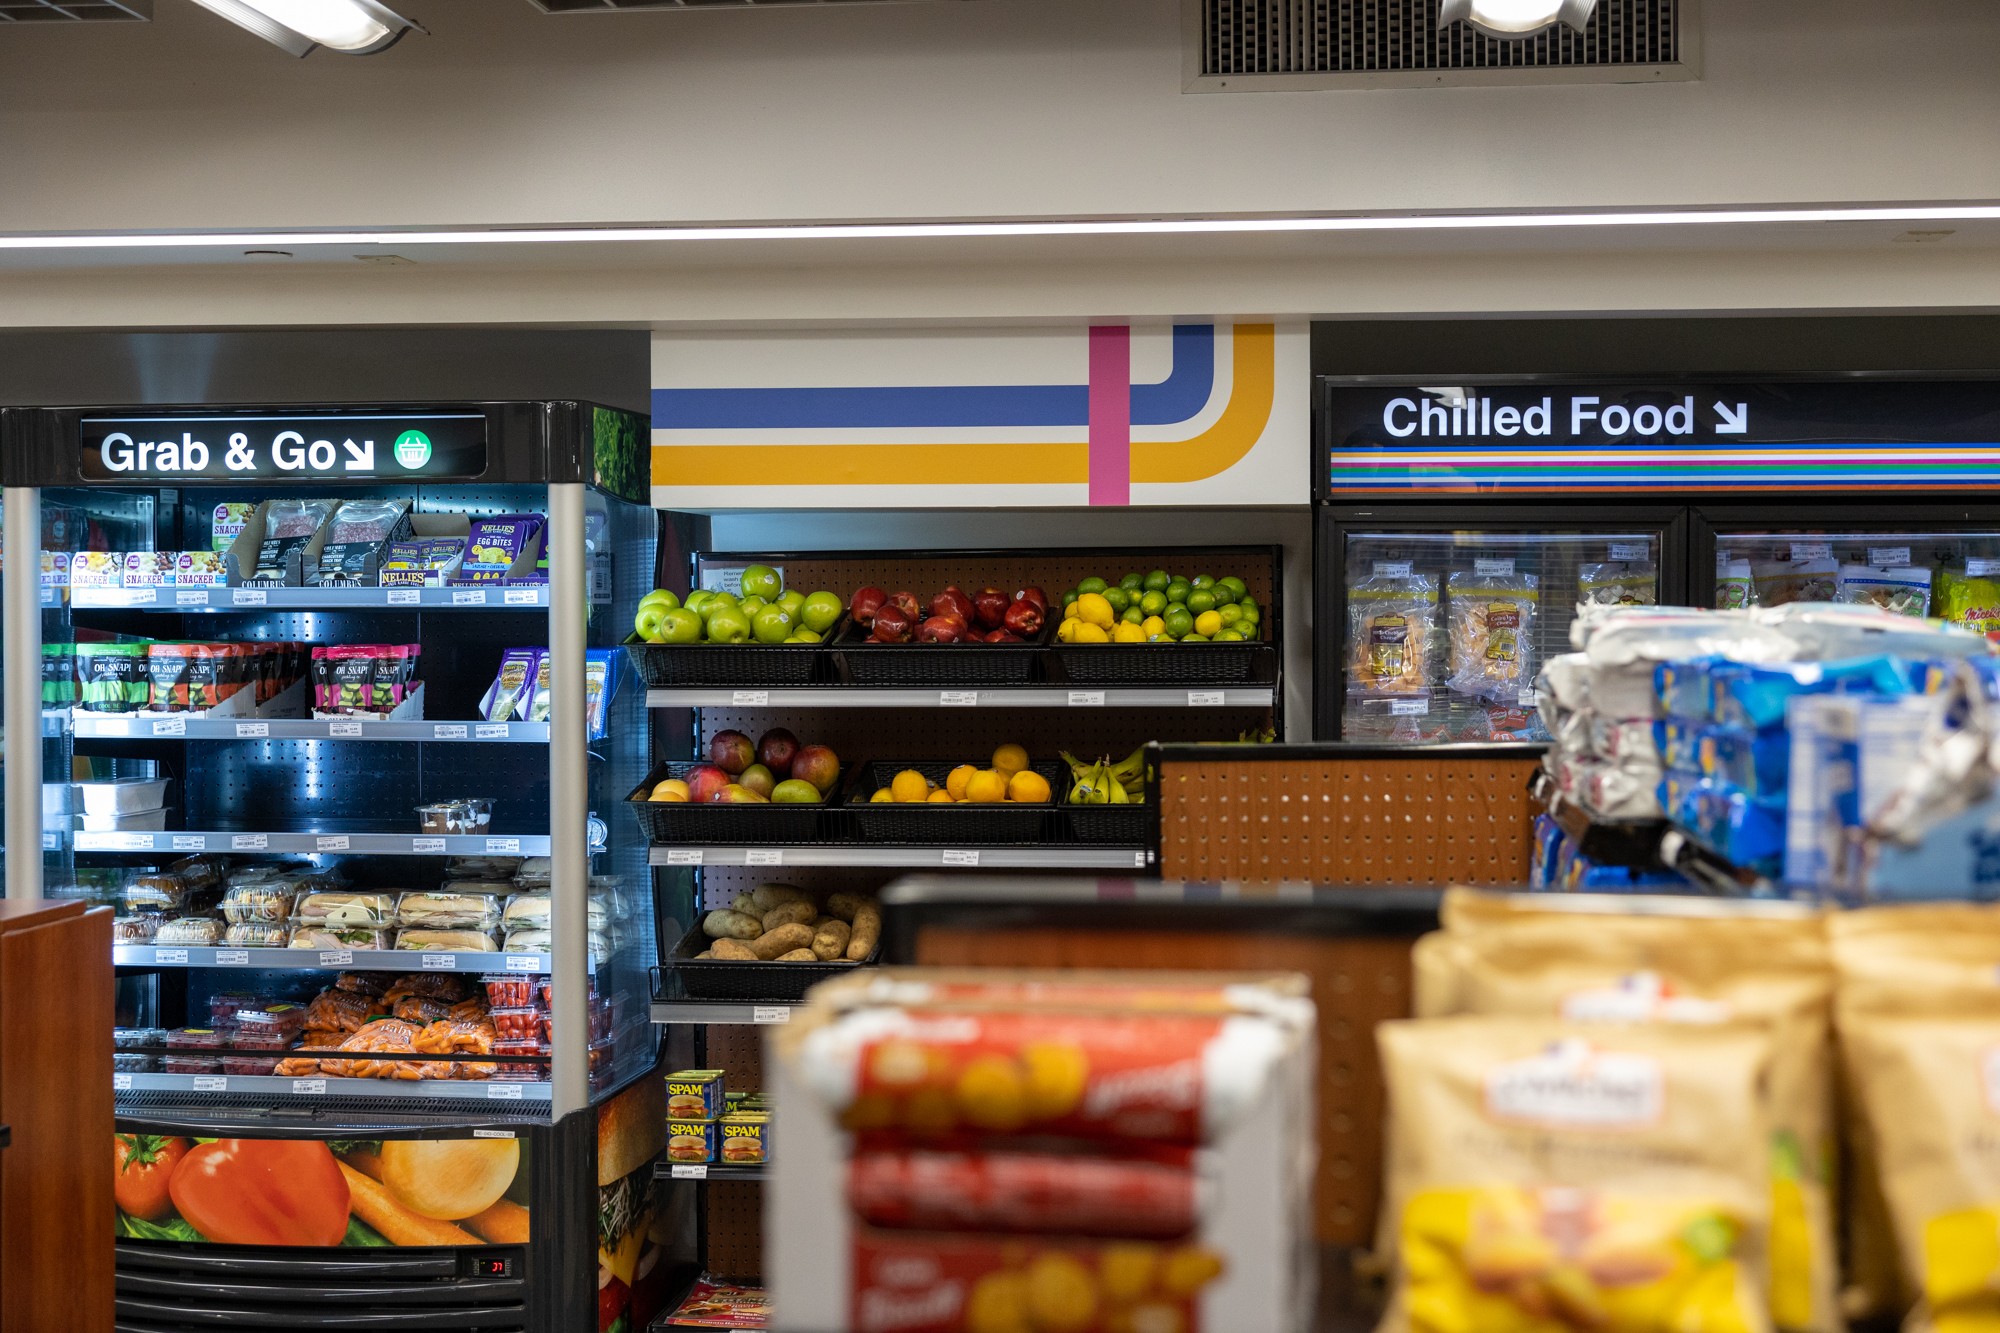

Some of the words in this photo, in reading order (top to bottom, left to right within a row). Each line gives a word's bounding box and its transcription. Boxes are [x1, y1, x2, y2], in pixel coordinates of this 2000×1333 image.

[1382, 396, 1552, 438] Chilled
[1570, 395, 1694, 437] Food
[100, 431, 210, 472] Grab
[224, 431, 257, 471] &
[271, 430, 337, 471] Go
[214, 525, 244, 534] SNACKE
[476, 537, 491, 546] EGG
[492, 538, 513, 547] BITES
[73, 575, 108, 585] SNACKER
[125, 574, 163, 584] SNACKER
[177, 574, 214, 584] SNACKER
[94, 663, 106, 672] OH
[107, 663, 131, 672] SNAP!
[150, 664, 160, 673] OH
[162, 664, 183, 673] SNAP!
[336, 666, 346, 675] OH
[347, 666, 369, 675] SNAP!
[380, 1023, 413, 1037] Baby
[668, 1083, 703, 1095] SPAM
[669, 1123, 705, 1135] SPAM
[724, 1125, 760, 1137] SPAM
